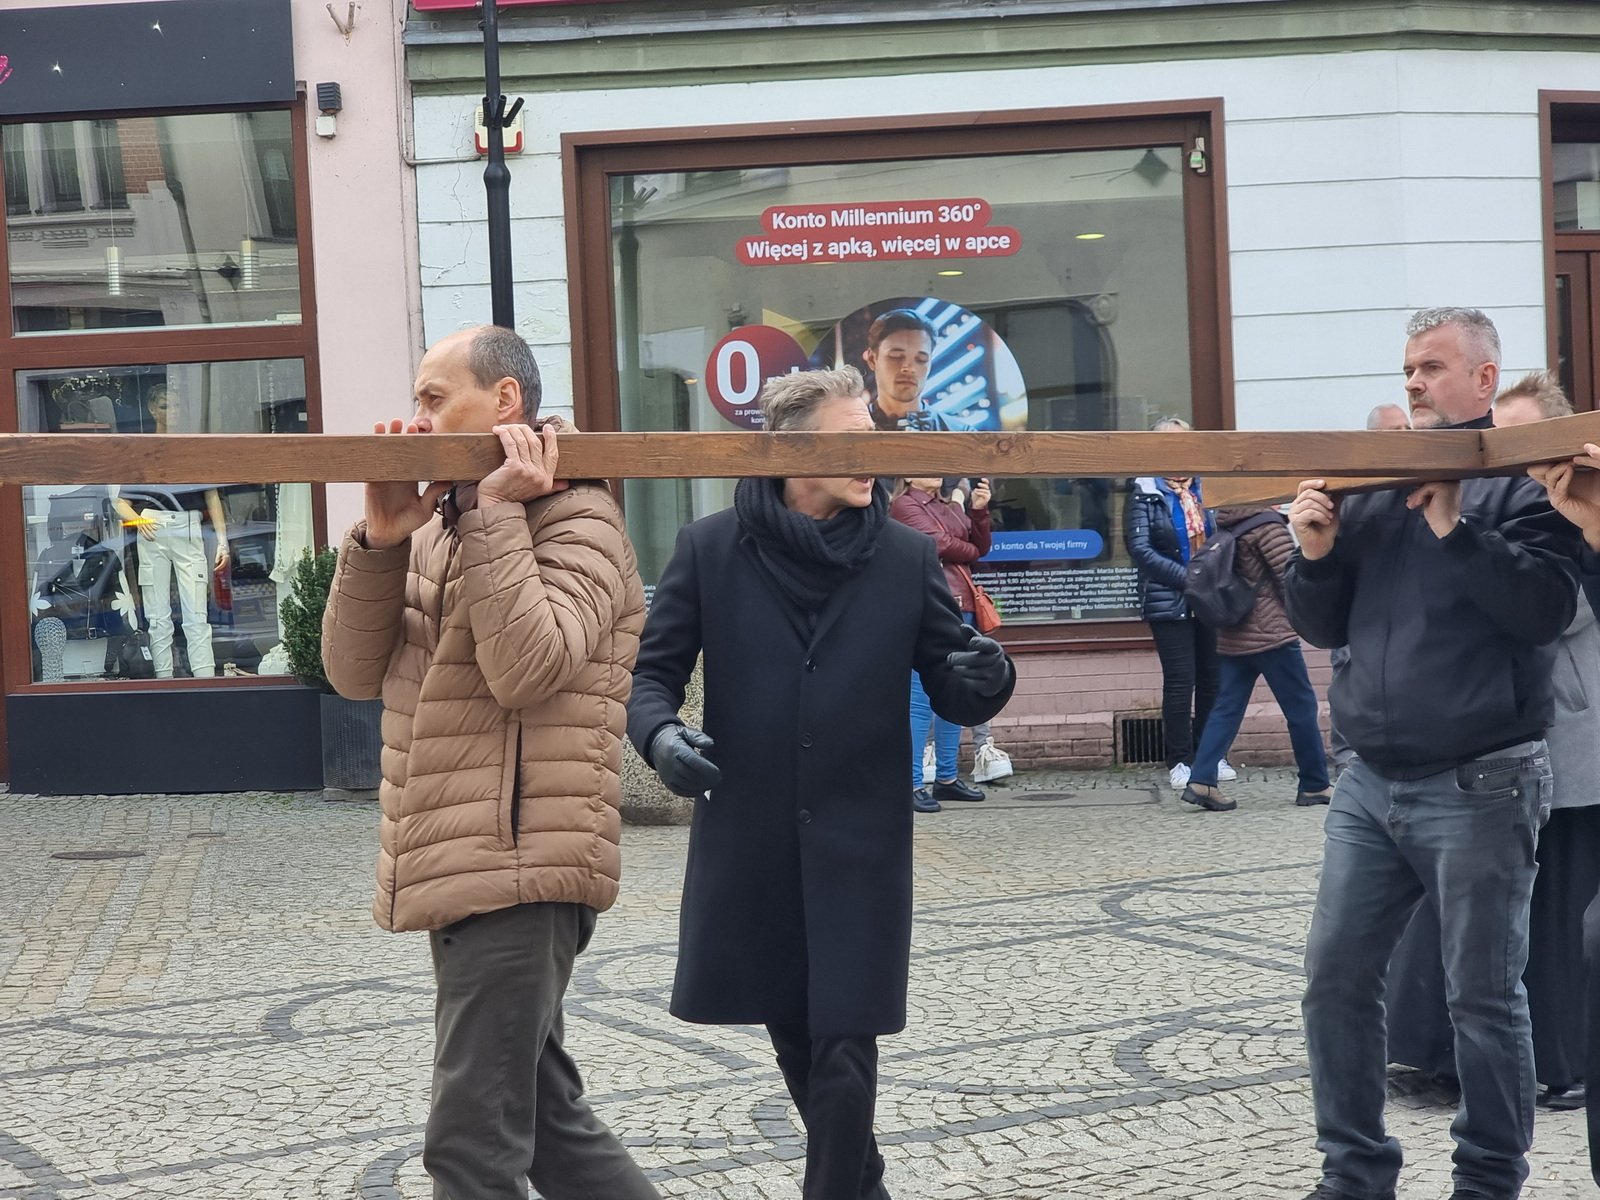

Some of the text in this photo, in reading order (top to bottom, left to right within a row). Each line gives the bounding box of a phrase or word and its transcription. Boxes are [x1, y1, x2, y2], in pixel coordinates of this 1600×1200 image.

[772, 203, 981, 230] Konto Millennium 360°
[746, 233, 1010, 261] Więcej z apką, więcej w apce
[716, 340, 760, 405] 0
[1001, 542, 1025, 551] konto
[1025, 541, 1038, 550] dla
[1040, 540, 1066, 551] Twojej
[1067, 540, 1088, 550] firmy
